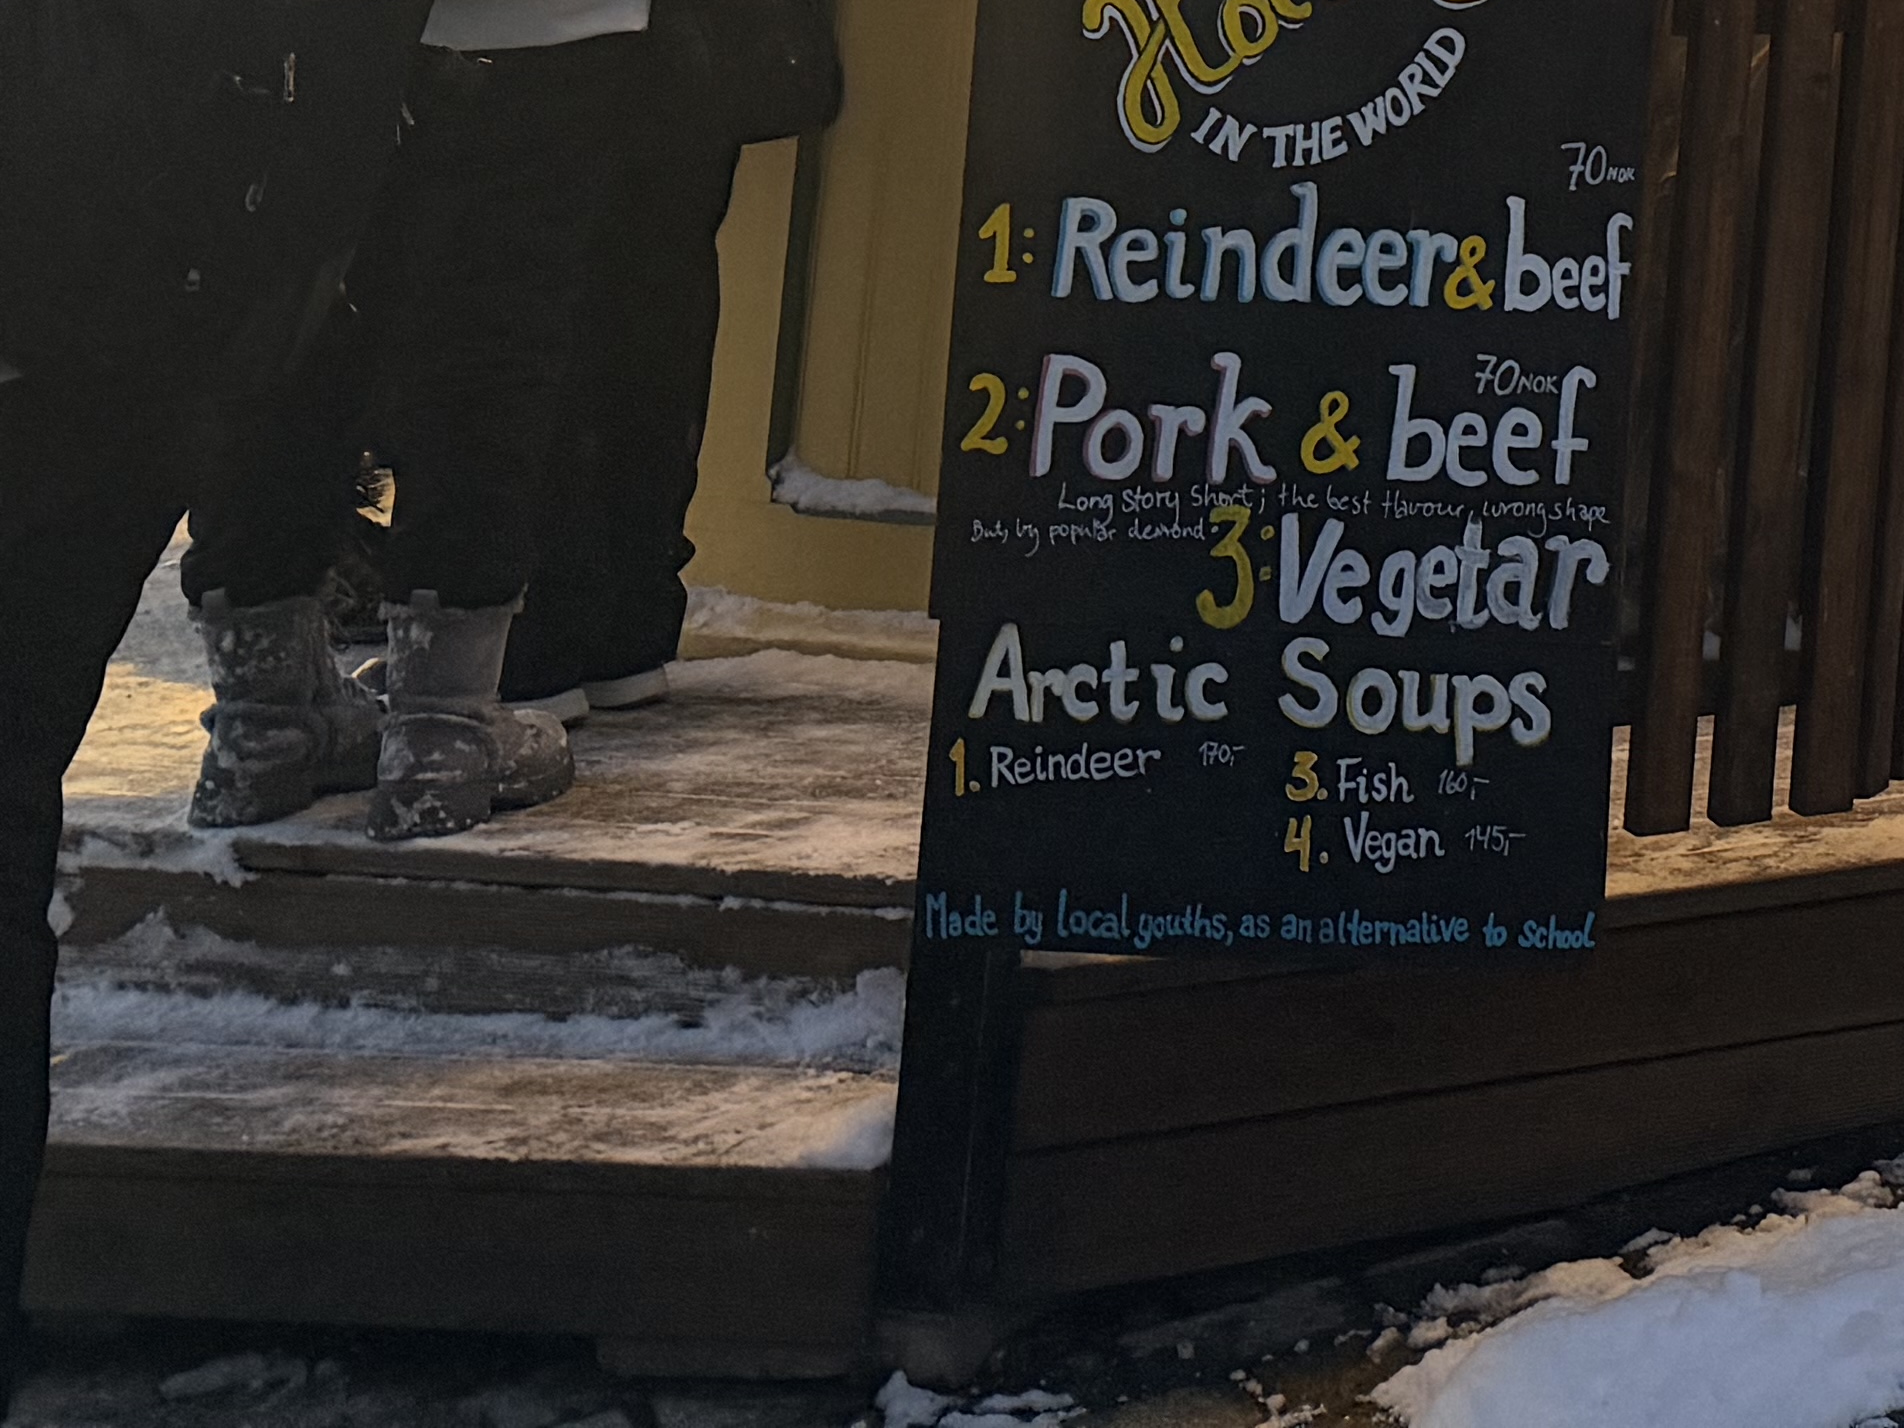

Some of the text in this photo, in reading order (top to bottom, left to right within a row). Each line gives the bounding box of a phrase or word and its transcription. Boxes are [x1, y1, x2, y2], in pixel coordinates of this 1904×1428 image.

[1190, 26, 1466, 170] IN THE WORLD
[977, 182, 1633, 320] 1: Reindeer & beef
[960, 351, 1597, 486] 2: Pork & beef
[1016, 517, 1041, 558] by
[1049, 517, 1118, 546] popular
[1058, 482, 1114, 526] Long
[1278, 482, 1320, 509] the
[1326, 484, 1372, 515] best
[1482, 500, 1548, 538] wrong
[1548, 497, 1611, 532] shape
[1195, 503, 1611, 638] 3: Vegetar
[967, 622, 1553, 767] Arctic Soups
[949, 737, 1162, 797] 1. Reindeer
[1285, 750, 1416, 804] 3. Fish
[1284, 810, 1446, 874] 4. Vegan
[925, 890, 1000, 939] Made
[1014, 890, 1043, 945] by
[1056, 888, 1131, 940] local
[1133, 902, 1234, 950] youths,
[1238, 913, 1271, 939] as
[1279, 912, 1313, 944] an
[1317, 908, 1470, 947] alternative
[1481, 910, 1508, 948] to
